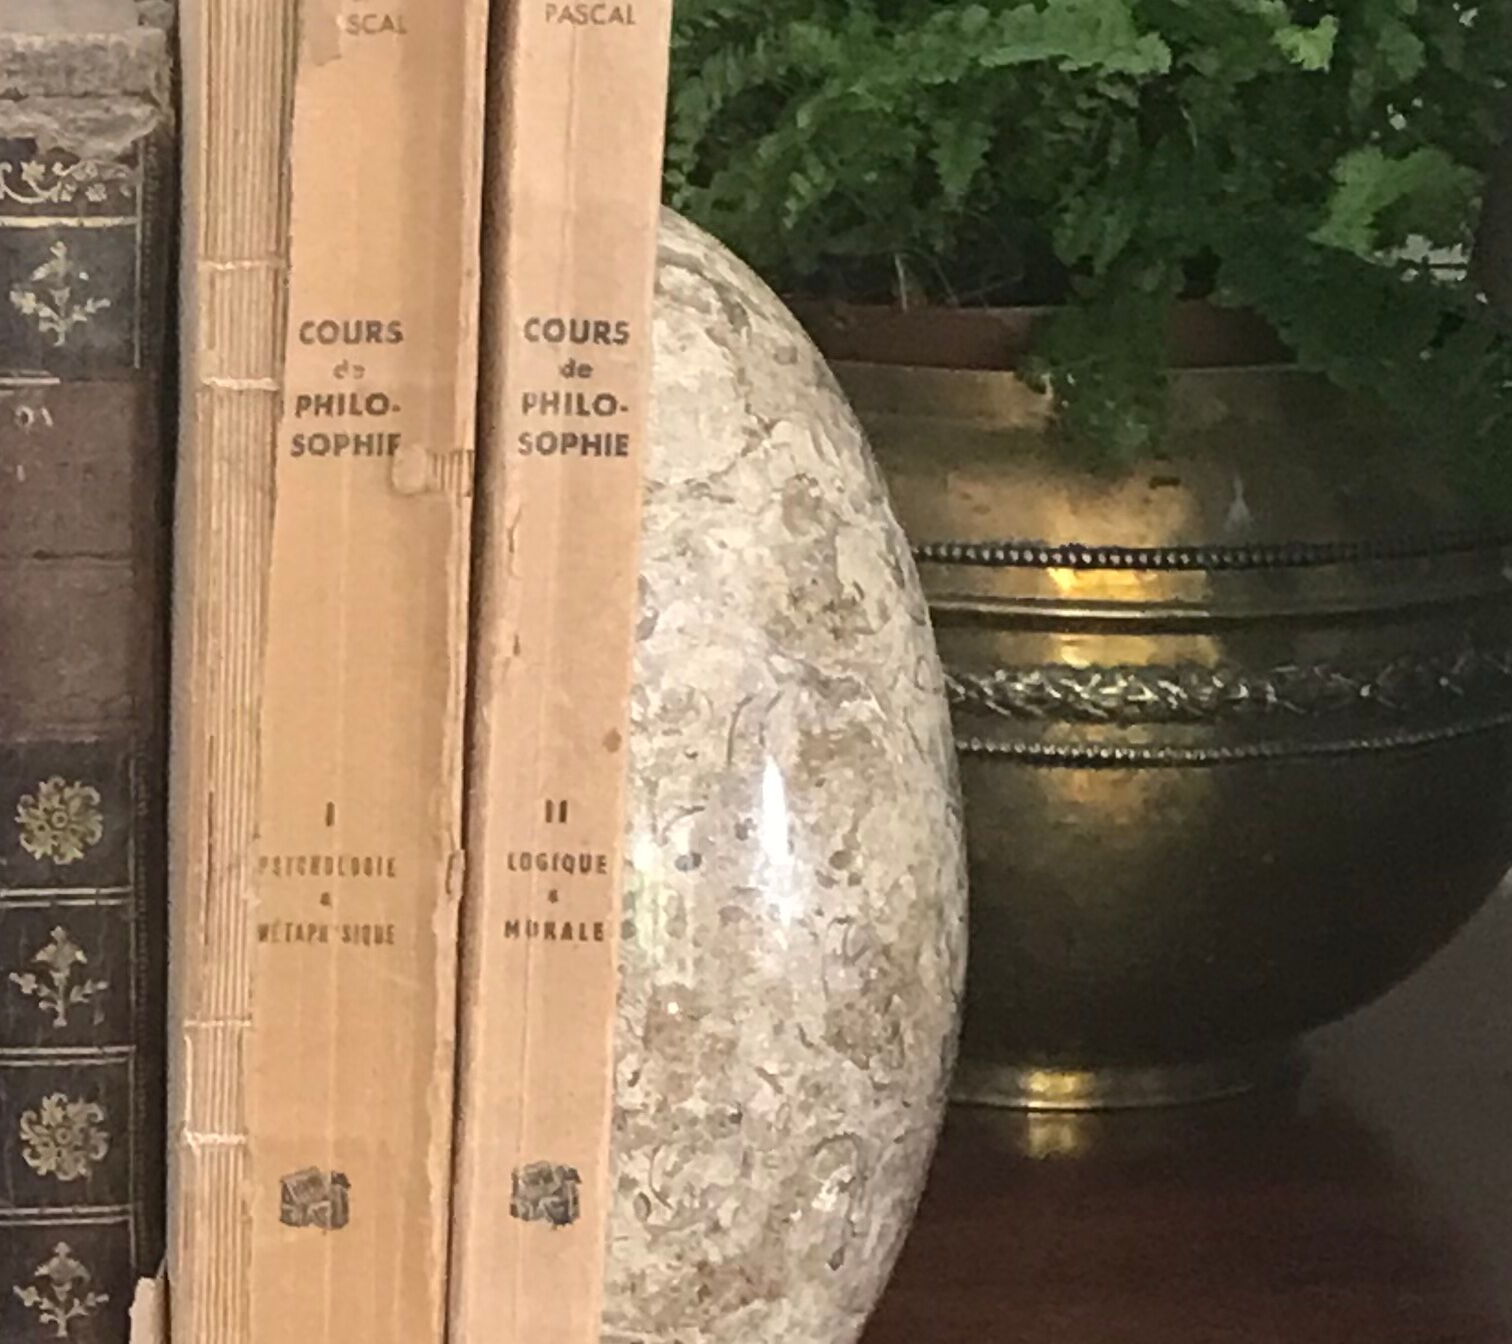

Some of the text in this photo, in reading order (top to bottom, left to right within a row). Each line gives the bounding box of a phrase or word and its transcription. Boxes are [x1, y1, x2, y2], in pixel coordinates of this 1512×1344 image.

[545, 3, 637, 26] PASCAL
[298, 319, 404, 346] COURS
[523, 317, 631, 346] COURS
[332, 359, 366, 380] de
[559, 357, 594, 379] de
[294, 392, 402, 419] PHILO-
[522, 392, 630, 417] PHILO-
[518, 430, 630, 457] SOPHIE
[544, 799, 568, 824] II
[507, 851, 607, 874] LOGIQUE
[503, 919, 604, 942] MORALE
